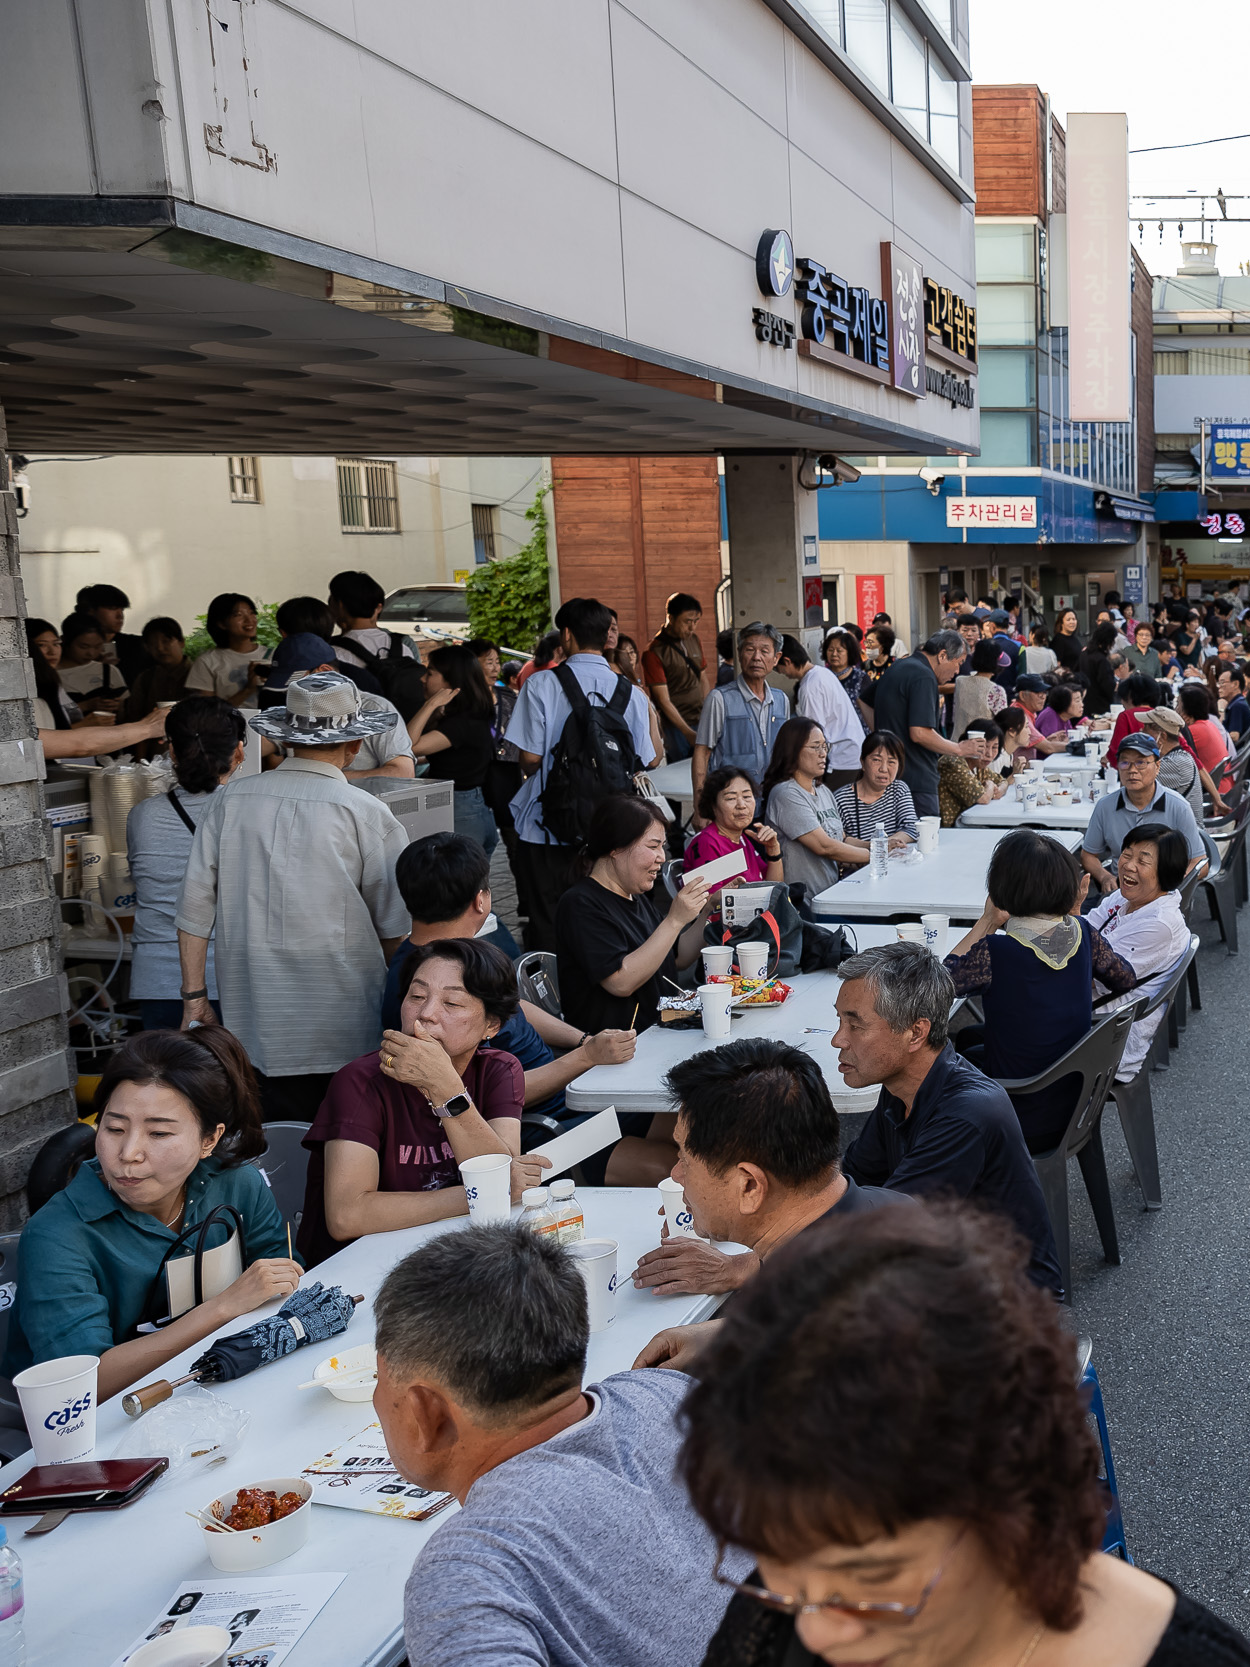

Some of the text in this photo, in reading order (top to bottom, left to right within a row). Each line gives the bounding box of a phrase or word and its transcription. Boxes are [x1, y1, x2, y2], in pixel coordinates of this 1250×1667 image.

[752, 307, 796, 350] 광진구
[795, 257, 889, 371] 중곡제일
[924, 278, 977, 362] 고객쉼터
[951, 503, 1034, 522] 주차관리실
[114, 892, 136, 907] Cas
[675, 1211, 692, 1228] Ca
[44, 1392, 92, 1431] Cass
